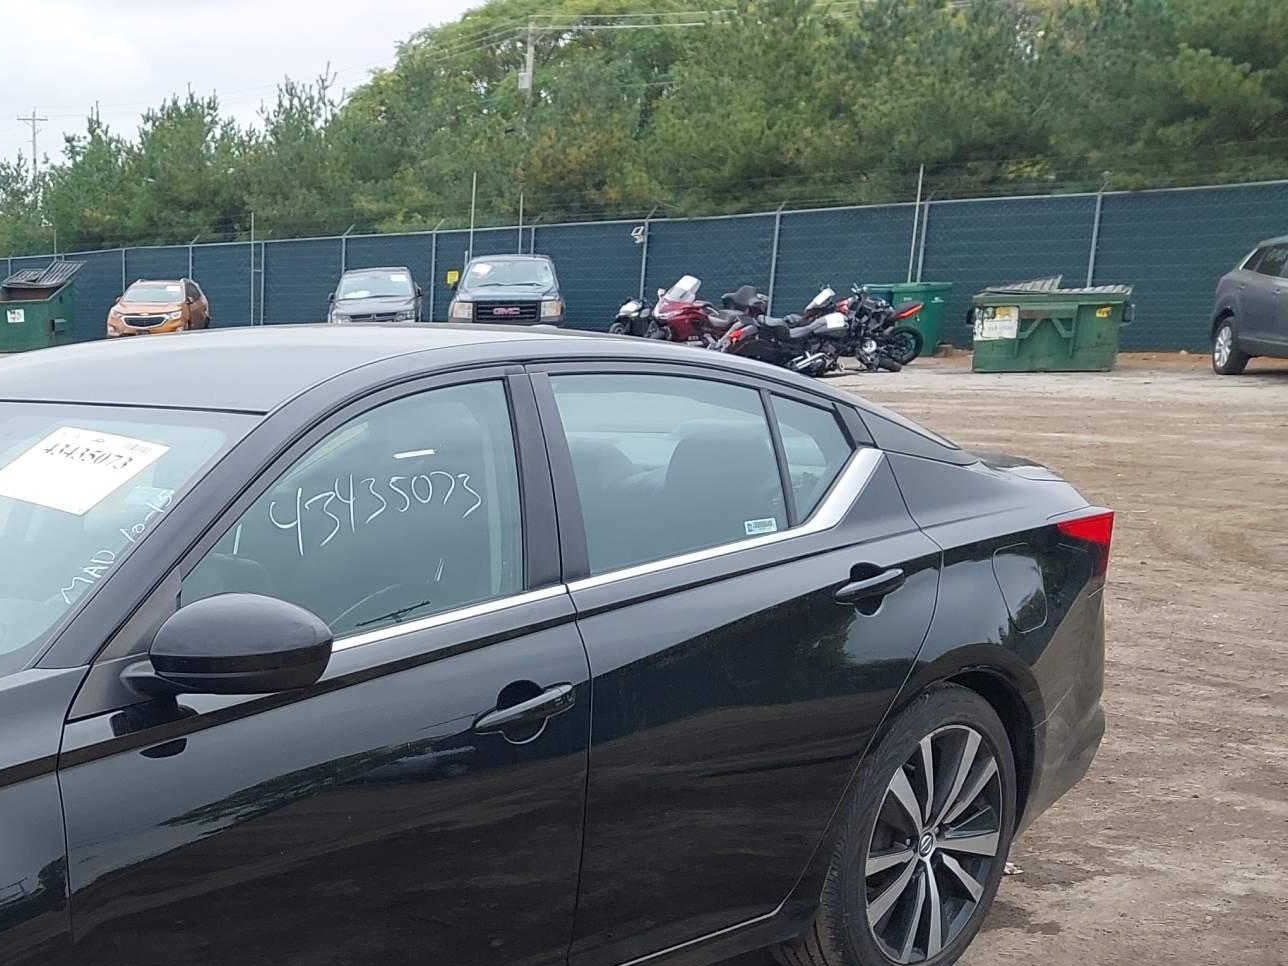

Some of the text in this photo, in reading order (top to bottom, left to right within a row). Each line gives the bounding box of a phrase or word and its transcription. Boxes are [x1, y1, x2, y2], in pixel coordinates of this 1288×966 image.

[493, 307, 521, 315] GMC
[43, 443, 134, 470] 43435073
[269, 471, 482, 557] 43435073
[60, 550, 116, 605] MAD
